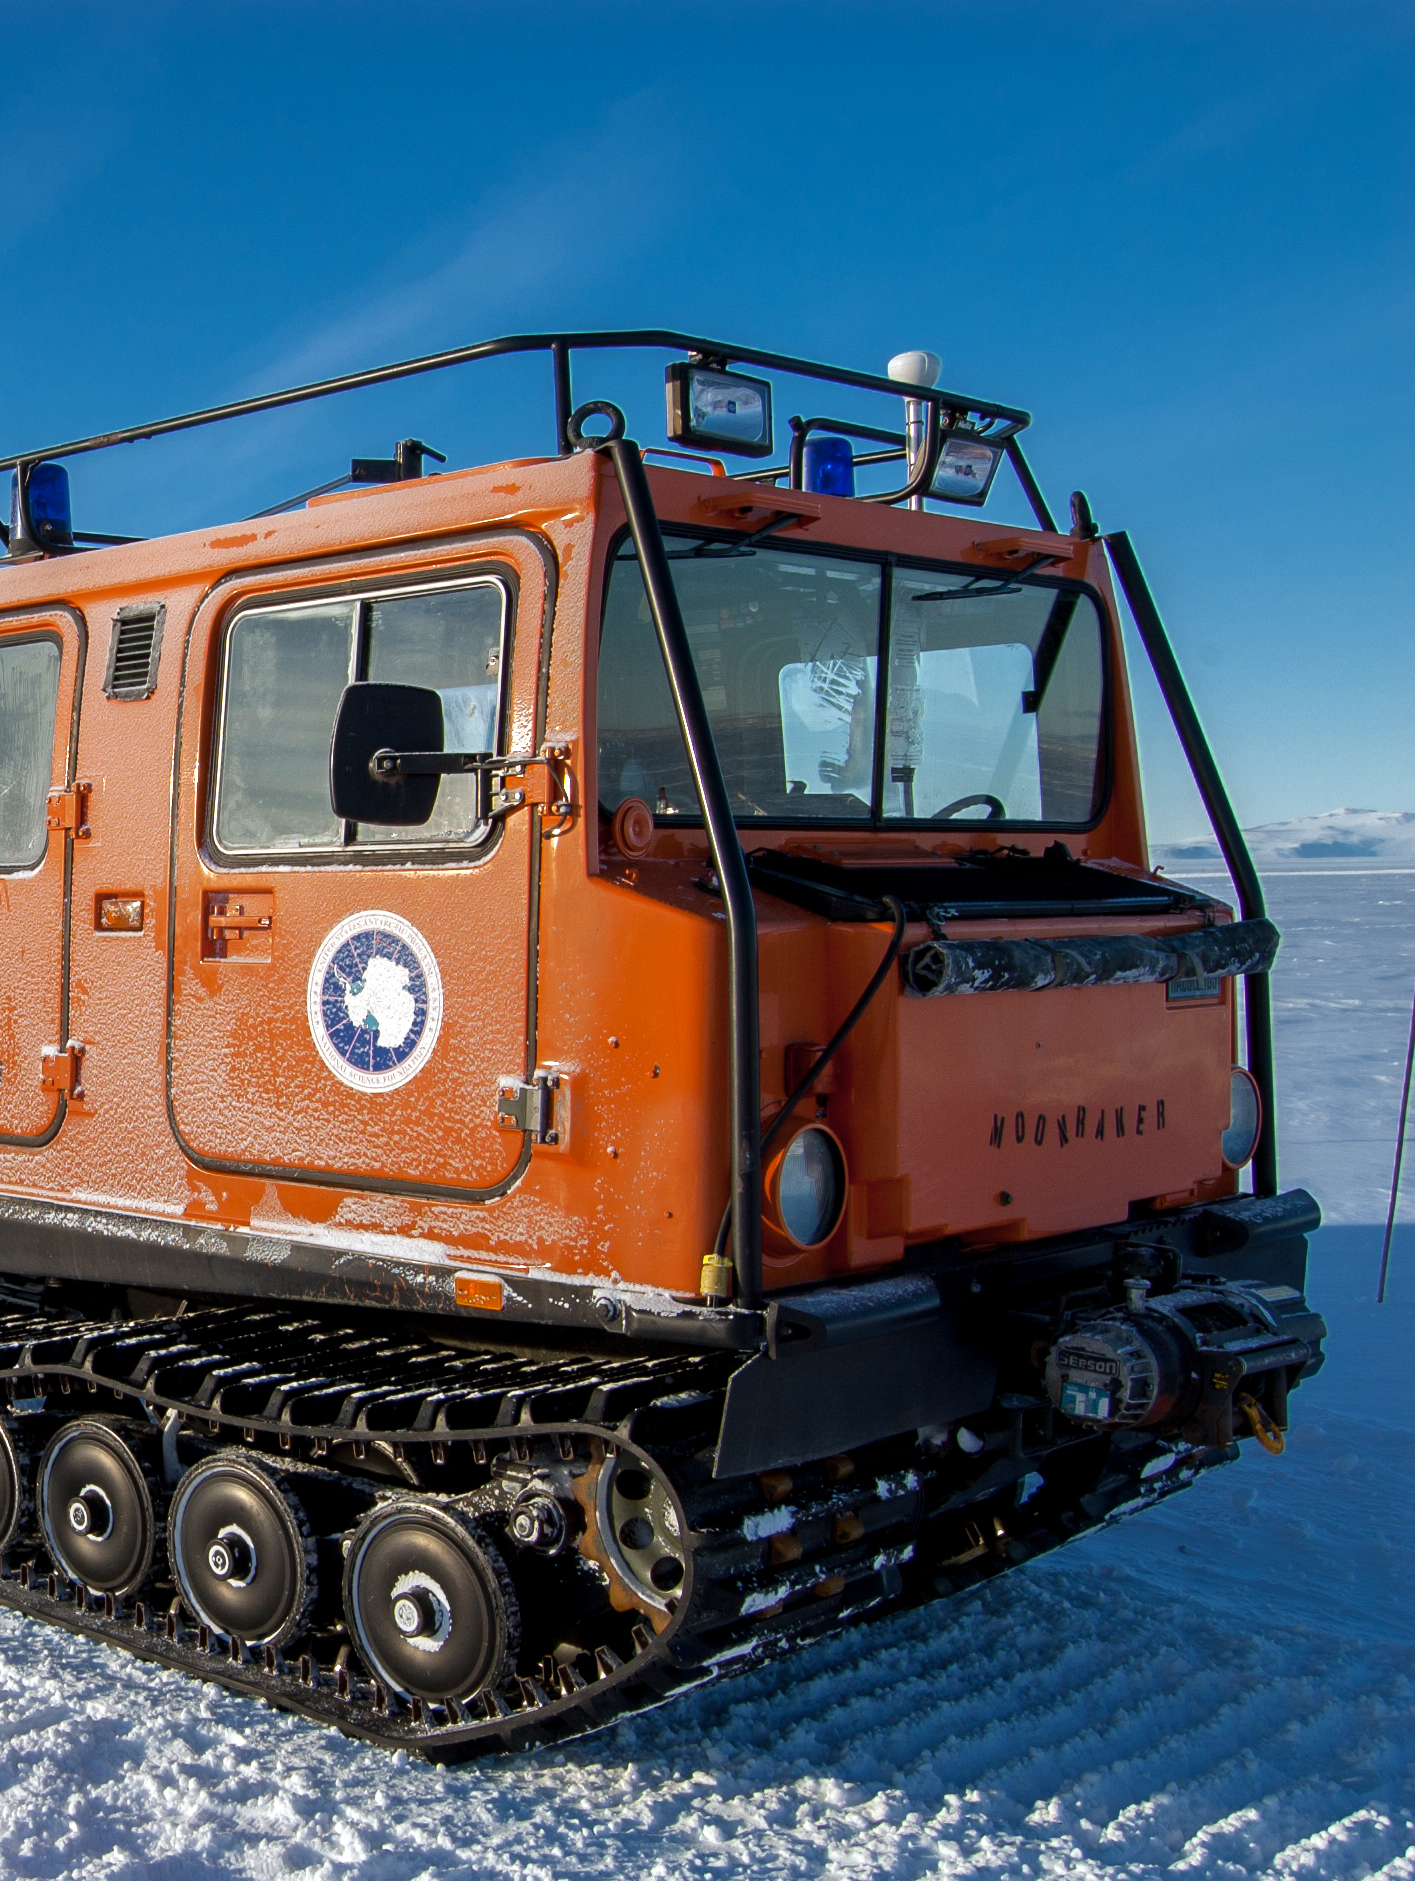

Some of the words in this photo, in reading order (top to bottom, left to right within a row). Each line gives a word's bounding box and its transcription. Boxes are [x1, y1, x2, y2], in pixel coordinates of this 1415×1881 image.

[320, 1033, 348, 1075] NATIONAL
[349, 1070, 382, 1085] SCIENCE
[382, 1045, 427, 1085] FOUNDATION
[988, 1099, 1166, 1150] MOONRAKER
